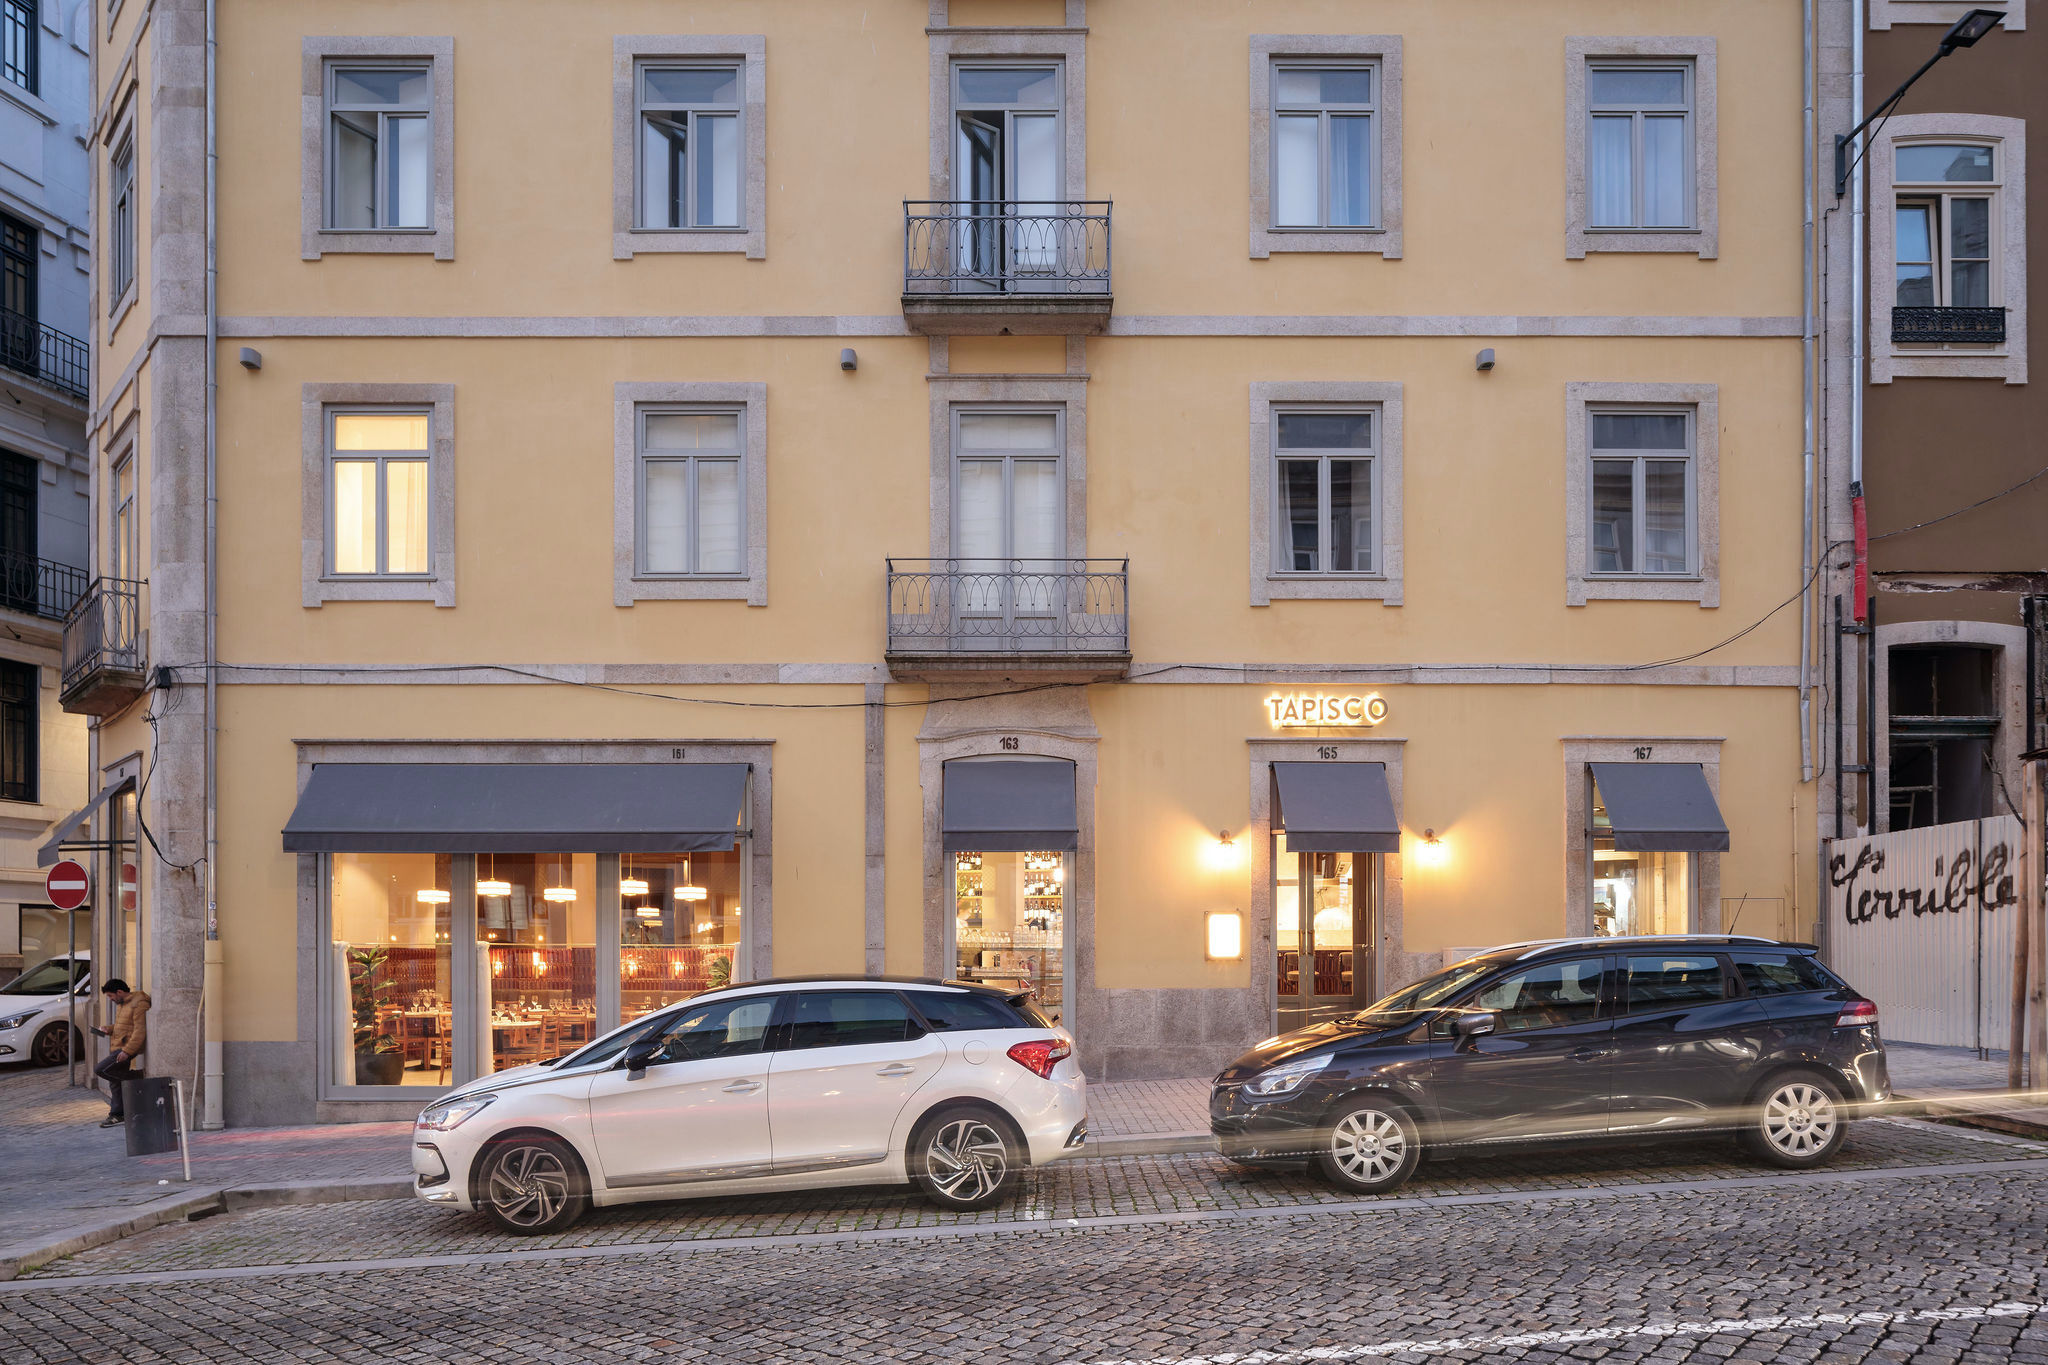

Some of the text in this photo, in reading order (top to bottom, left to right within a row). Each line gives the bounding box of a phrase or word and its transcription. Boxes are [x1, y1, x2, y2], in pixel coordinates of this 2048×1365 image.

[1270, 697, 1389, 721] TAPISCO
[999, 736, 1019, 750] 163
[672, 748, 685, 759] 161
[1316, 746, 1338, 760] 165
[1633, 746, 1652, 760] 167
[1830, 841, 2018, 925] Terrible
